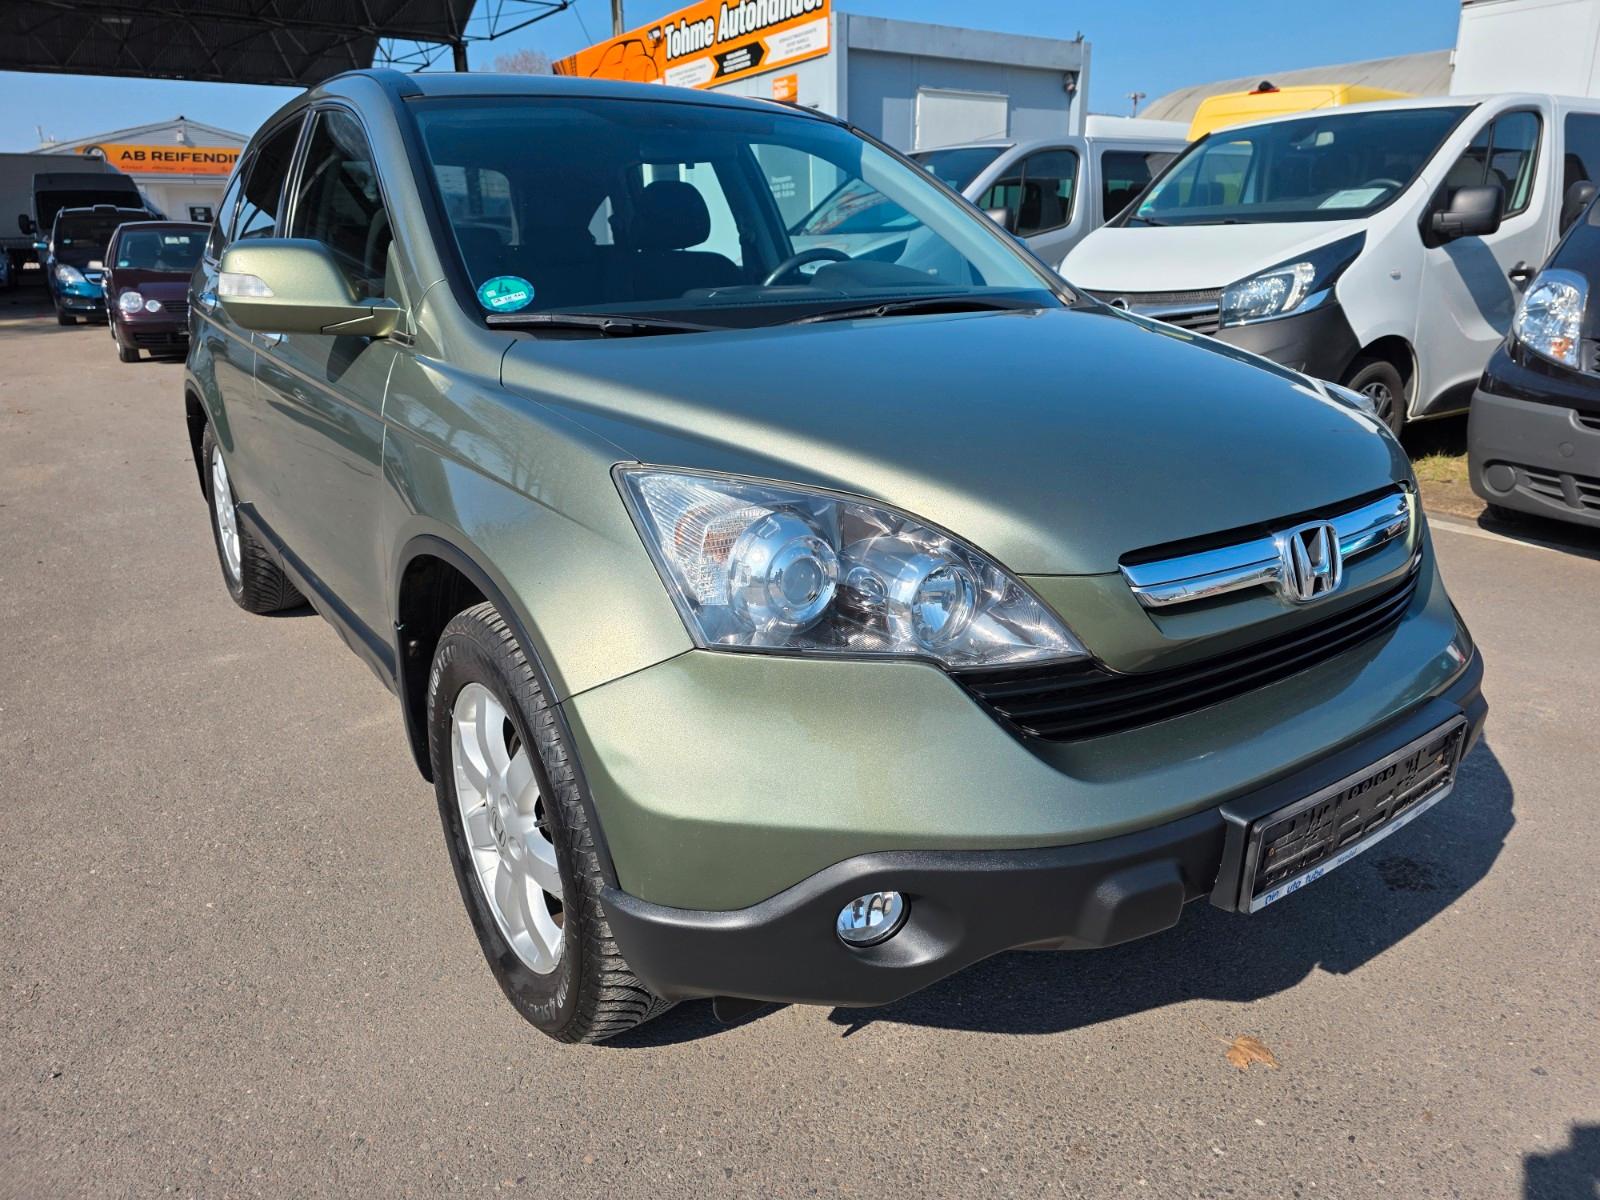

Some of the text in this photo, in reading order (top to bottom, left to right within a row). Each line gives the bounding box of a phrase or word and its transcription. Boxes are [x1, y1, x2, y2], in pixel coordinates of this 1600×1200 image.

[665, 17, 714, 60] Tohme
[717, 0, 823, 43] Autohan
[121, 151, 146, 161] AB
